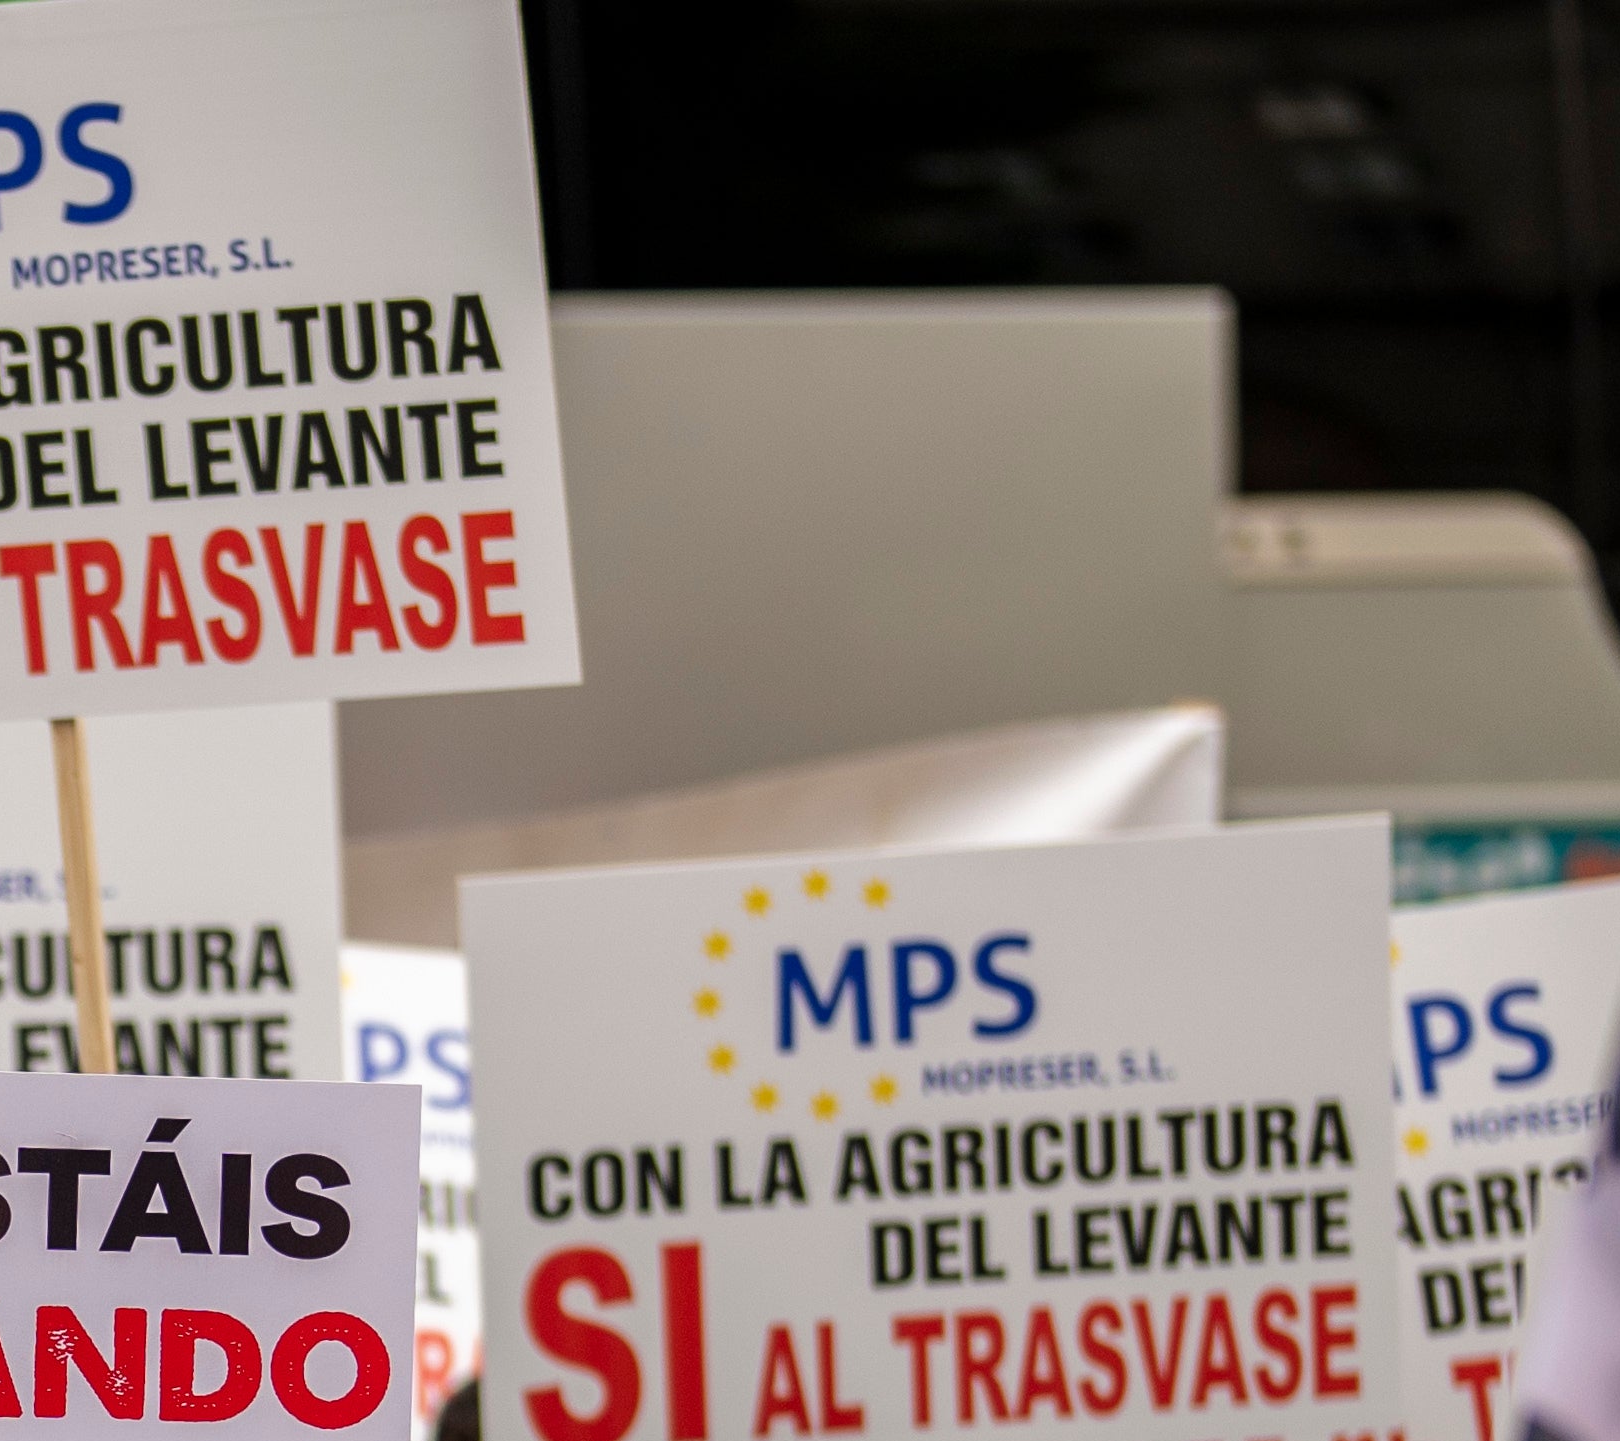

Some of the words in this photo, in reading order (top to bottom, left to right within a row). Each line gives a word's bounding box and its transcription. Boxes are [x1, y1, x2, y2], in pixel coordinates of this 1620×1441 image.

[11, 245, 220, 289] MOPRESER,
[228, 237, 293, 273] S.L.
[146, 398, 504, 501] LEVANTE
[776, 932, 1039, 1055] MPS
[1398, 981, 1556, 1102] PS
[358, 1021, 472, 1110] PS
[528, 1146, 687, 1223] CON
[715, 1137, 809, 1209] LA
[835, 1099, 1355, 1203] AGRICULTURA
[870, 1218, 1006, 1292] DEL
[1033, 1191, 1355, 1276] LEVANTE
[891, 1283, 1362, 1431] TRASVASE
